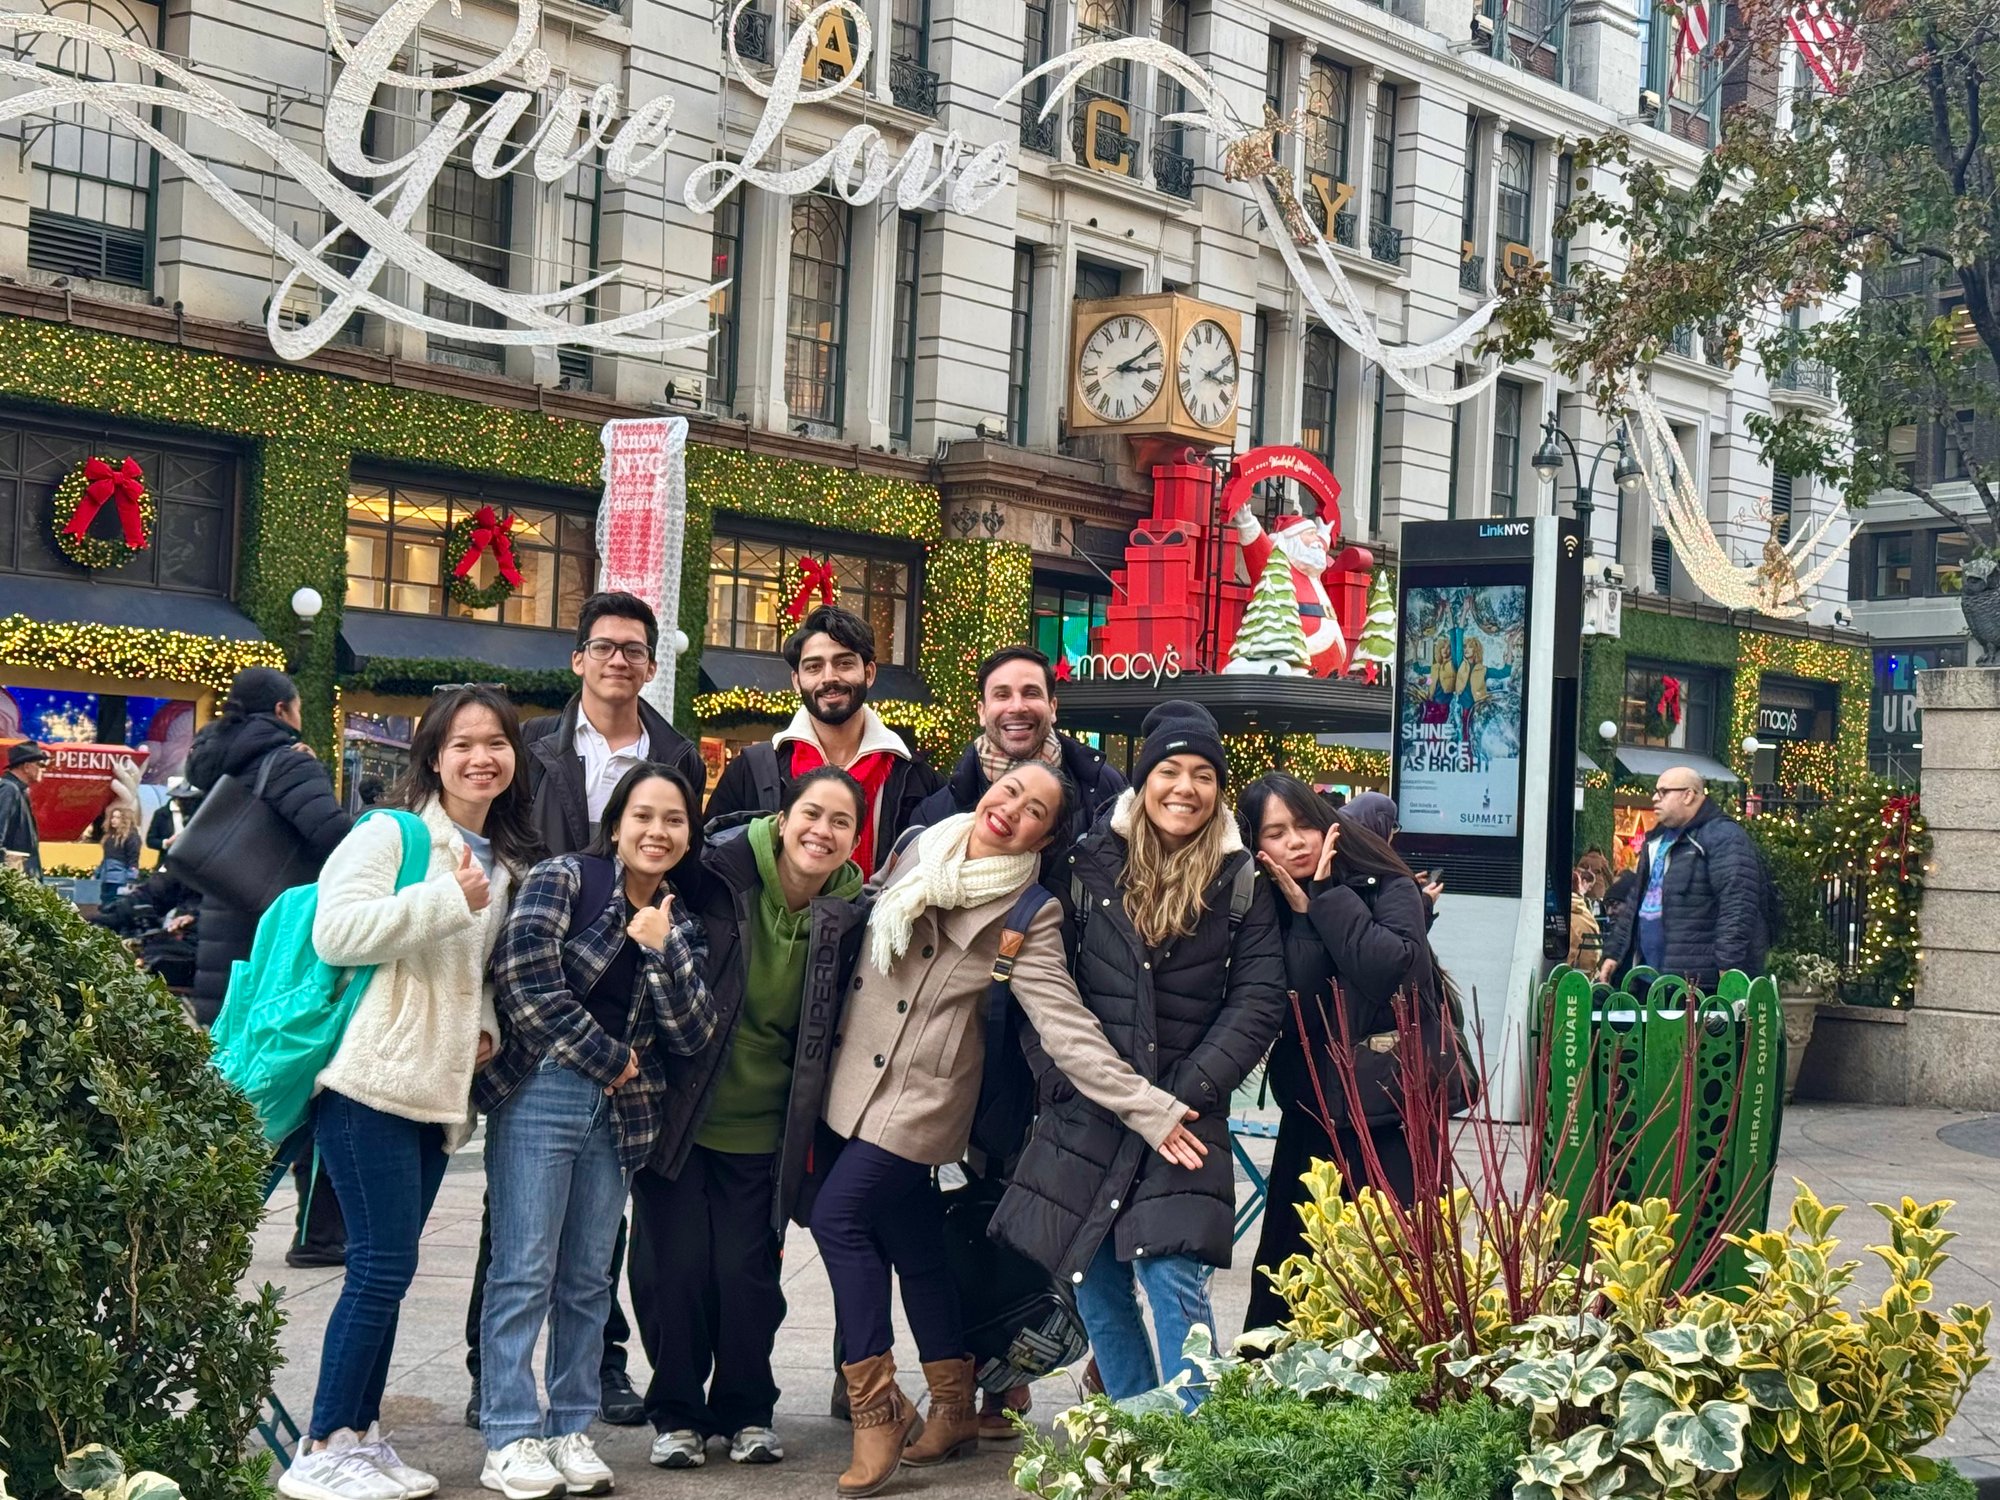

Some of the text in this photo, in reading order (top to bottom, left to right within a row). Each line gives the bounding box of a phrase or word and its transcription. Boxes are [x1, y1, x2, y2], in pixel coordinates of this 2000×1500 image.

[801, 6, 863, 89] A
[1086, 98, 1131, 175] C
[1311, 174, 1355, 242] Y
[267, 0, 1013, 361] Give Love
[615, 452, 667, 476] NYC
[1480, 523, 1530, 537] LinkNYC
[1077, 643, 1180, 688] macy's
[1401, 723, 1456, 740] SHINE
[1760, 709, 1798, 736] macy's
[56, 751, 132, 770] PEEKING
[1412, 741, 1470, 758] TWICE
[1402, 755, 1489, 773] AS BRIGHT
[1460, 813, 1512, 825] SUMMIT
[805, 907, 840, 1062] SUPERDRY
[1565, 995, 1577, 1068] SQUARE
[1749, 1002, 1767, 1153] HERALD SQUARE
